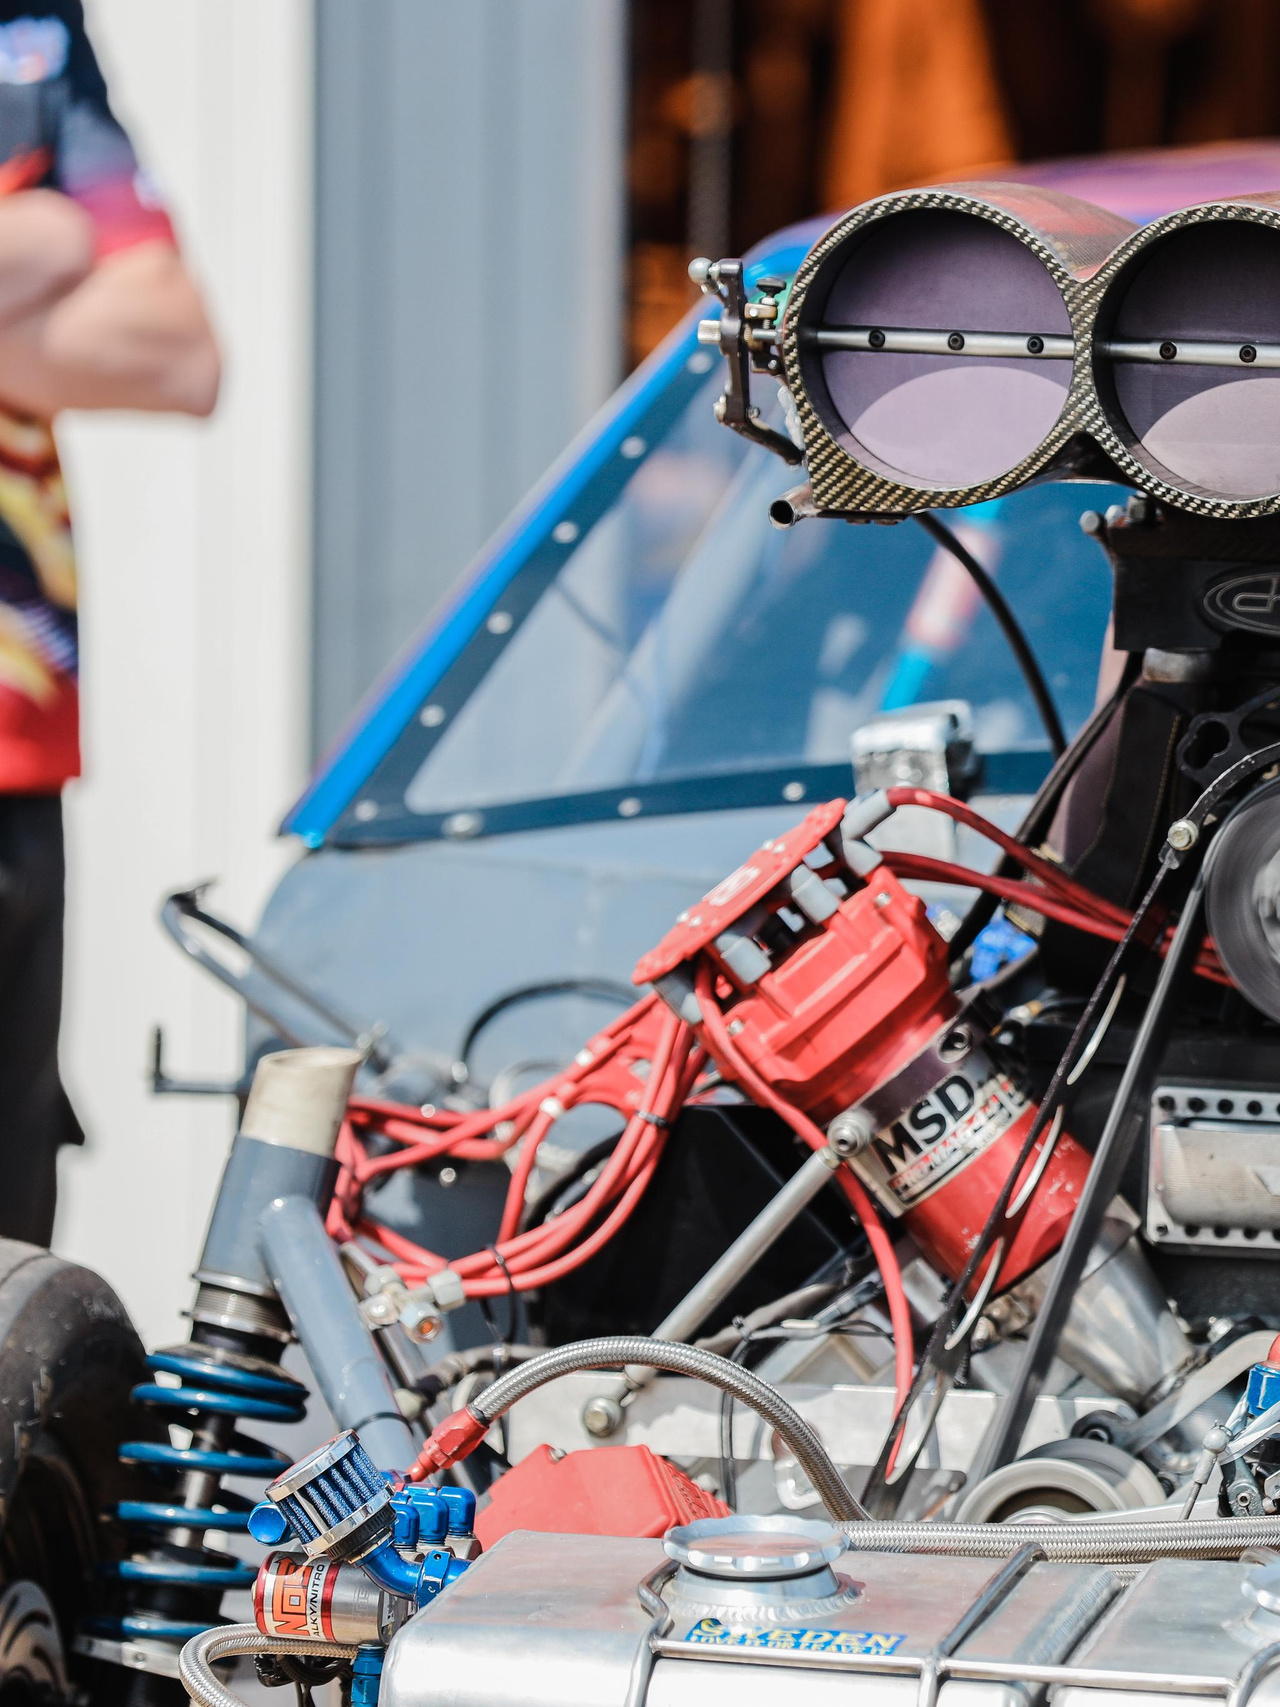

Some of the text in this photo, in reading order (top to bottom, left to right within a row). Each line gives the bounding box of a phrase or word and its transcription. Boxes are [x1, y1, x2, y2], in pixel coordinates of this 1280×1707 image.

[871, 1075, 975, 1175] MSD
[272, 1557, 314, 1637] NOS
[307, 1564, 325, 1637] ALKY/NITRO
[692, 1618, 901, 1648] SWEDEN
